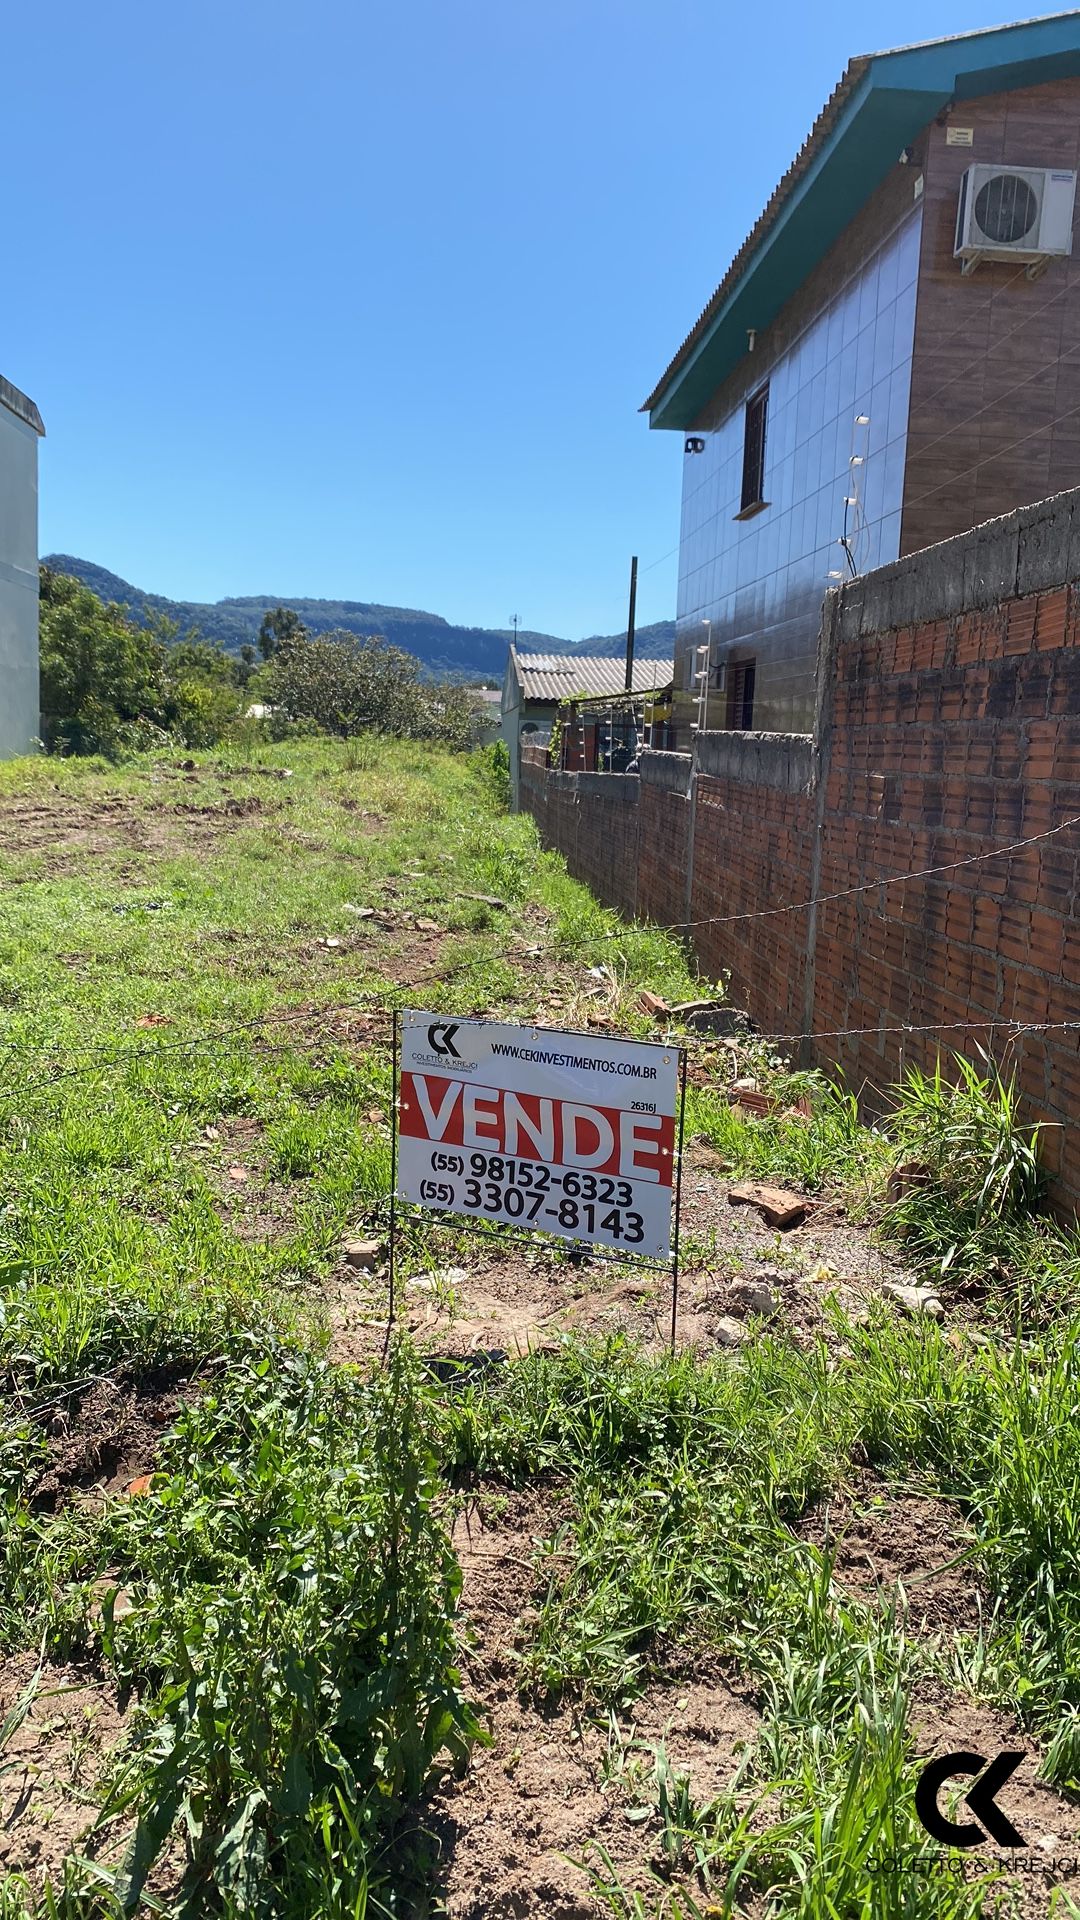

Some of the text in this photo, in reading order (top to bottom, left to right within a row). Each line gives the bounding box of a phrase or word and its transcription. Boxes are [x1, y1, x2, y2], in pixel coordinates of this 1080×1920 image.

[427, 1023, 462, 1058] CK
[411, 1052, 443, 1063] COLETTO
[452, 1060, 478, 1070] KREJCI
[491, 1043, 657, 1080] WWW.CEKINVESTIMENTOS.COM.BR
[630, 1100, 657, 1114] 26316J
[412, 1074, 663, 1183] VENDE
[430, 1151, 633, 1208] (55) 98152-6323
[419, 1179, 645, 1243] (55) 3307-8143
